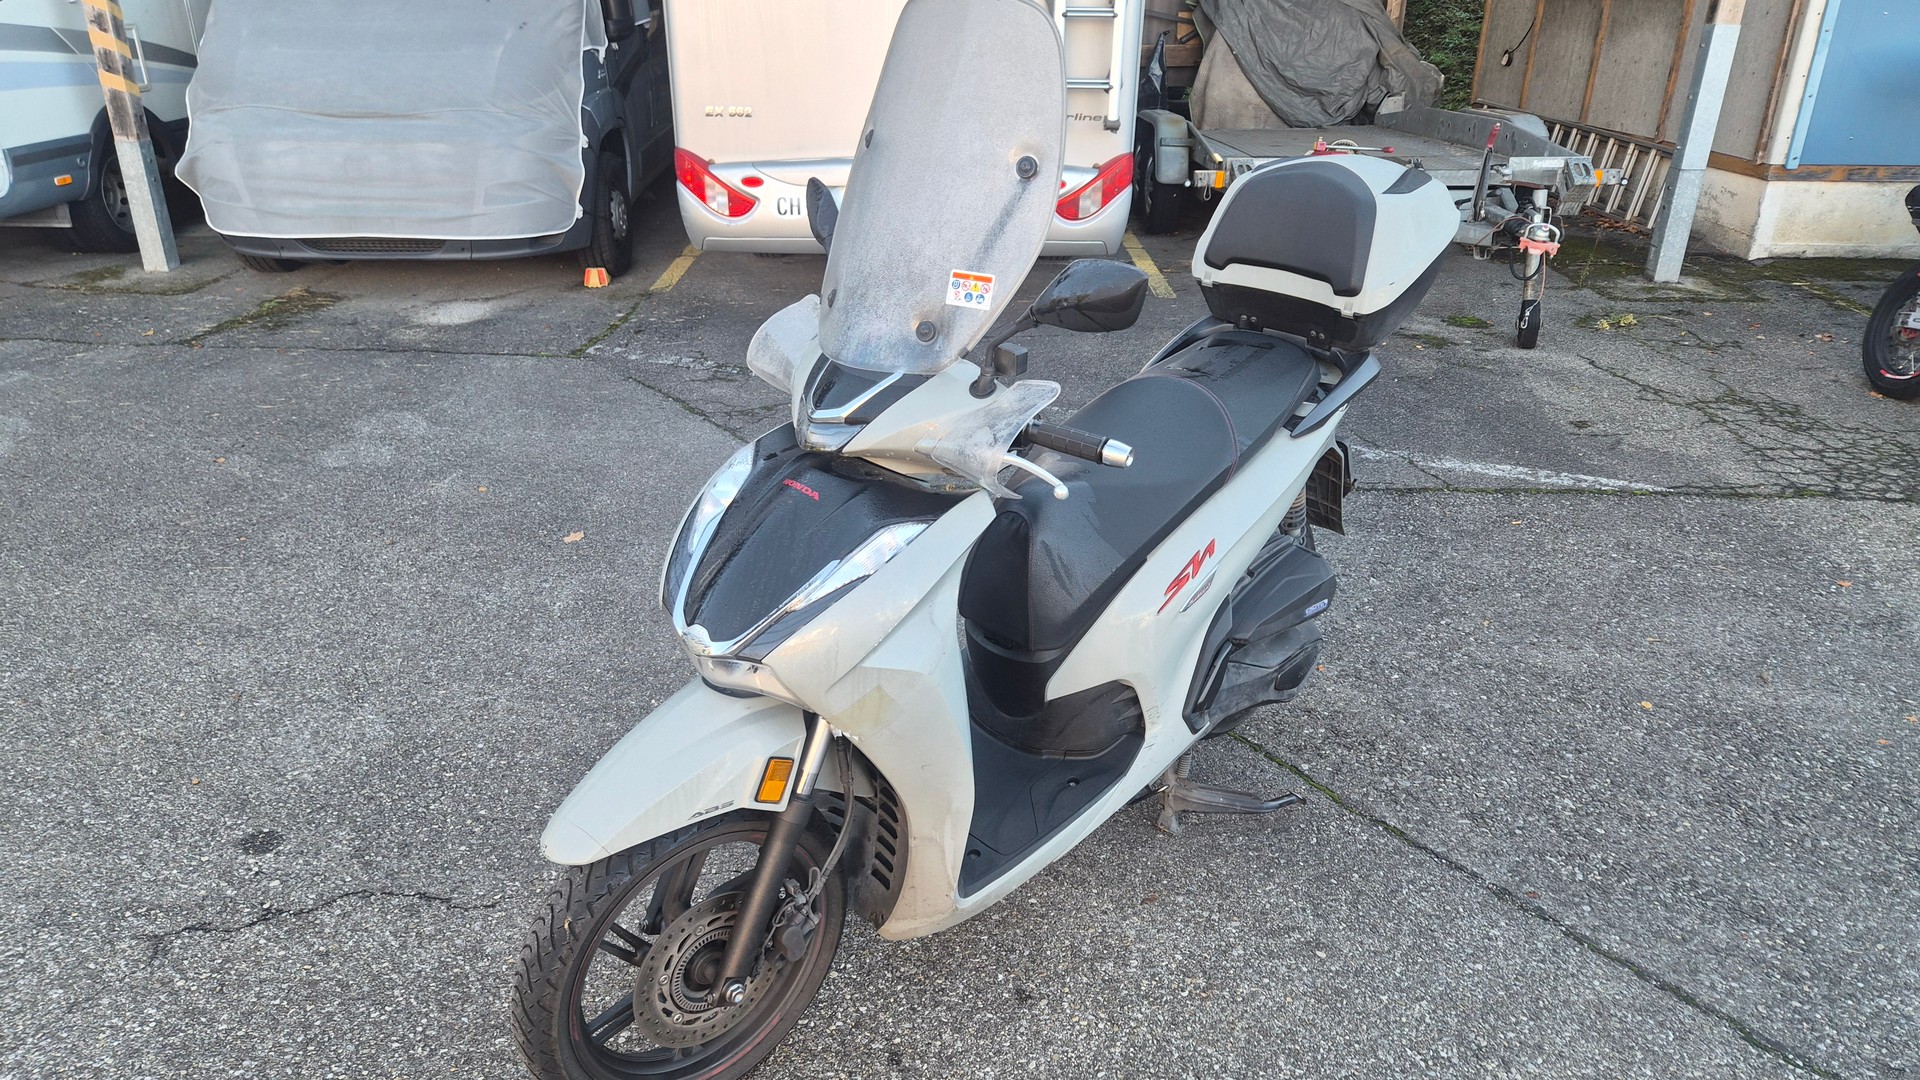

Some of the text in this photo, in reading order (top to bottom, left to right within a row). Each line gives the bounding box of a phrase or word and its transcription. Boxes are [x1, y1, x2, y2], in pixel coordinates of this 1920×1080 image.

[705, 105, 724, 118] EX
[1066, 113, 1103, 121] rline
[777, 197, 801, 216] CH
[783, 479, 819, 501] HONDA
